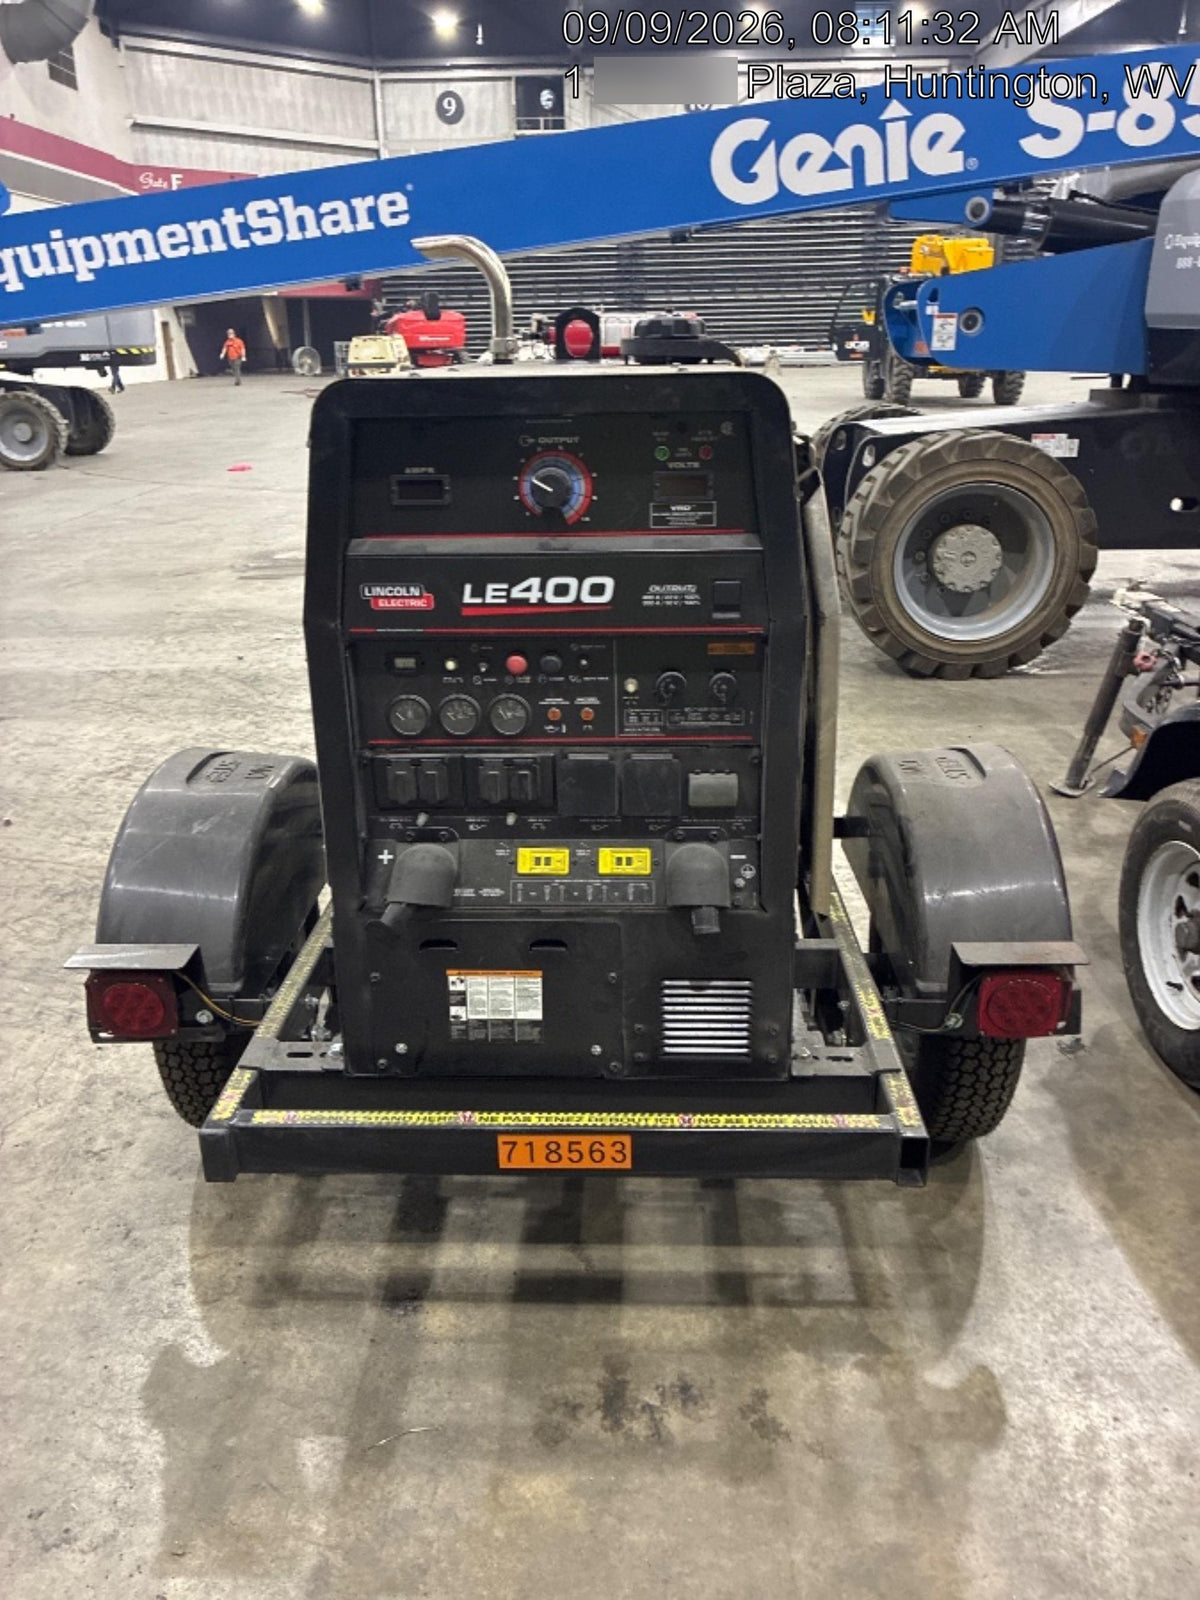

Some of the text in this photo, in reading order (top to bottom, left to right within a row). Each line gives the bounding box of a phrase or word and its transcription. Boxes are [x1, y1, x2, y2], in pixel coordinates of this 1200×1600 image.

[442, 96, 457, 117] 9
[710, 99, 966, 206] Genie
[364, 585, 422, 598] LINCOLN
[462, 575, 615, 604] LE400
[377, 598, 428, 608] ELECTRIC
[502, 1140, 627, 1164] 718563
